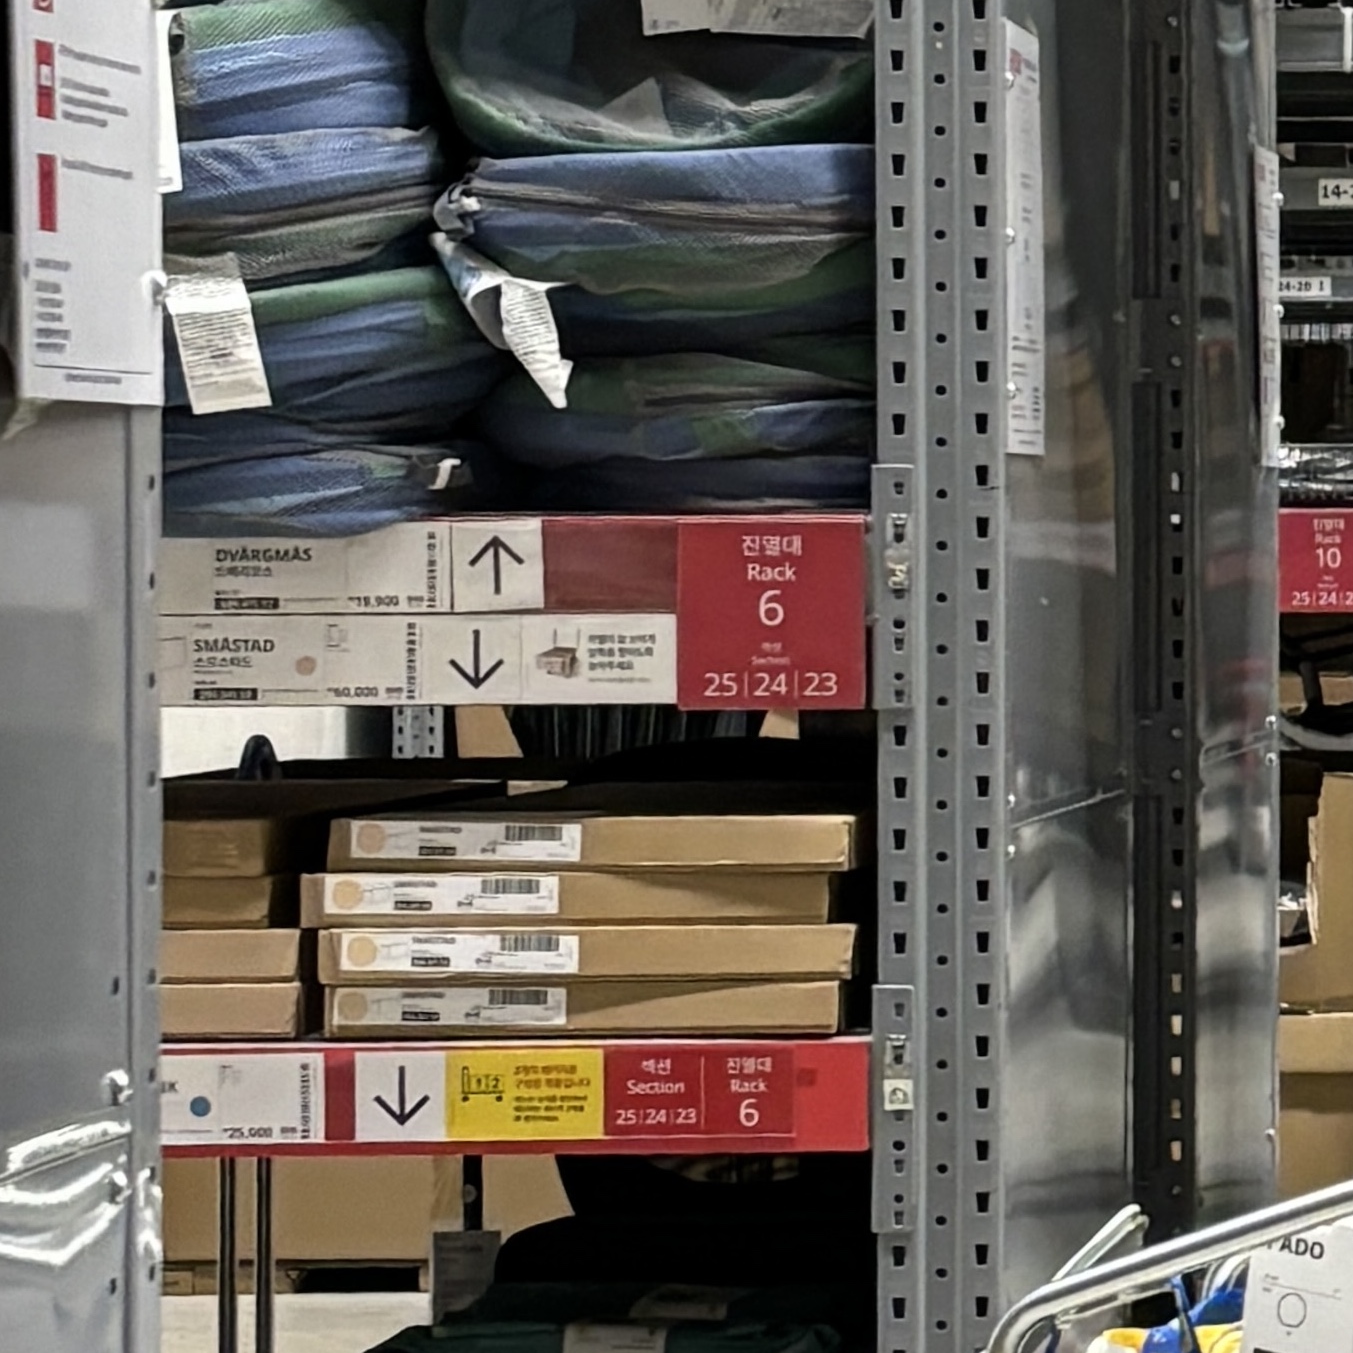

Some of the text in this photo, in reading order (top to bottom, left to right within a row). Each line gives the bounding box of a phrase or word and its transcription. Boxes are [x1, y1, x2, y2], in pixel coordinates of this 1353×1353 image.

[1316, 548, 1342, 569] 10
[746, 562, 796, 581] Rack
[759, 589, 784, 626] 6
[1291, 592, 1310, 606] 25
[1319, 592, 1338, 606] 24
[193, 637, 275, 653] SMÅSTAD
[703, 672, 838, 697] 25 24 23
[627, 1078, 685, 1096] Section
[730, 1077, 768, 1094] Rack
[615, 1107, 697, 1125] 25 24 23
[739, 1098, 759, 1127] 6
